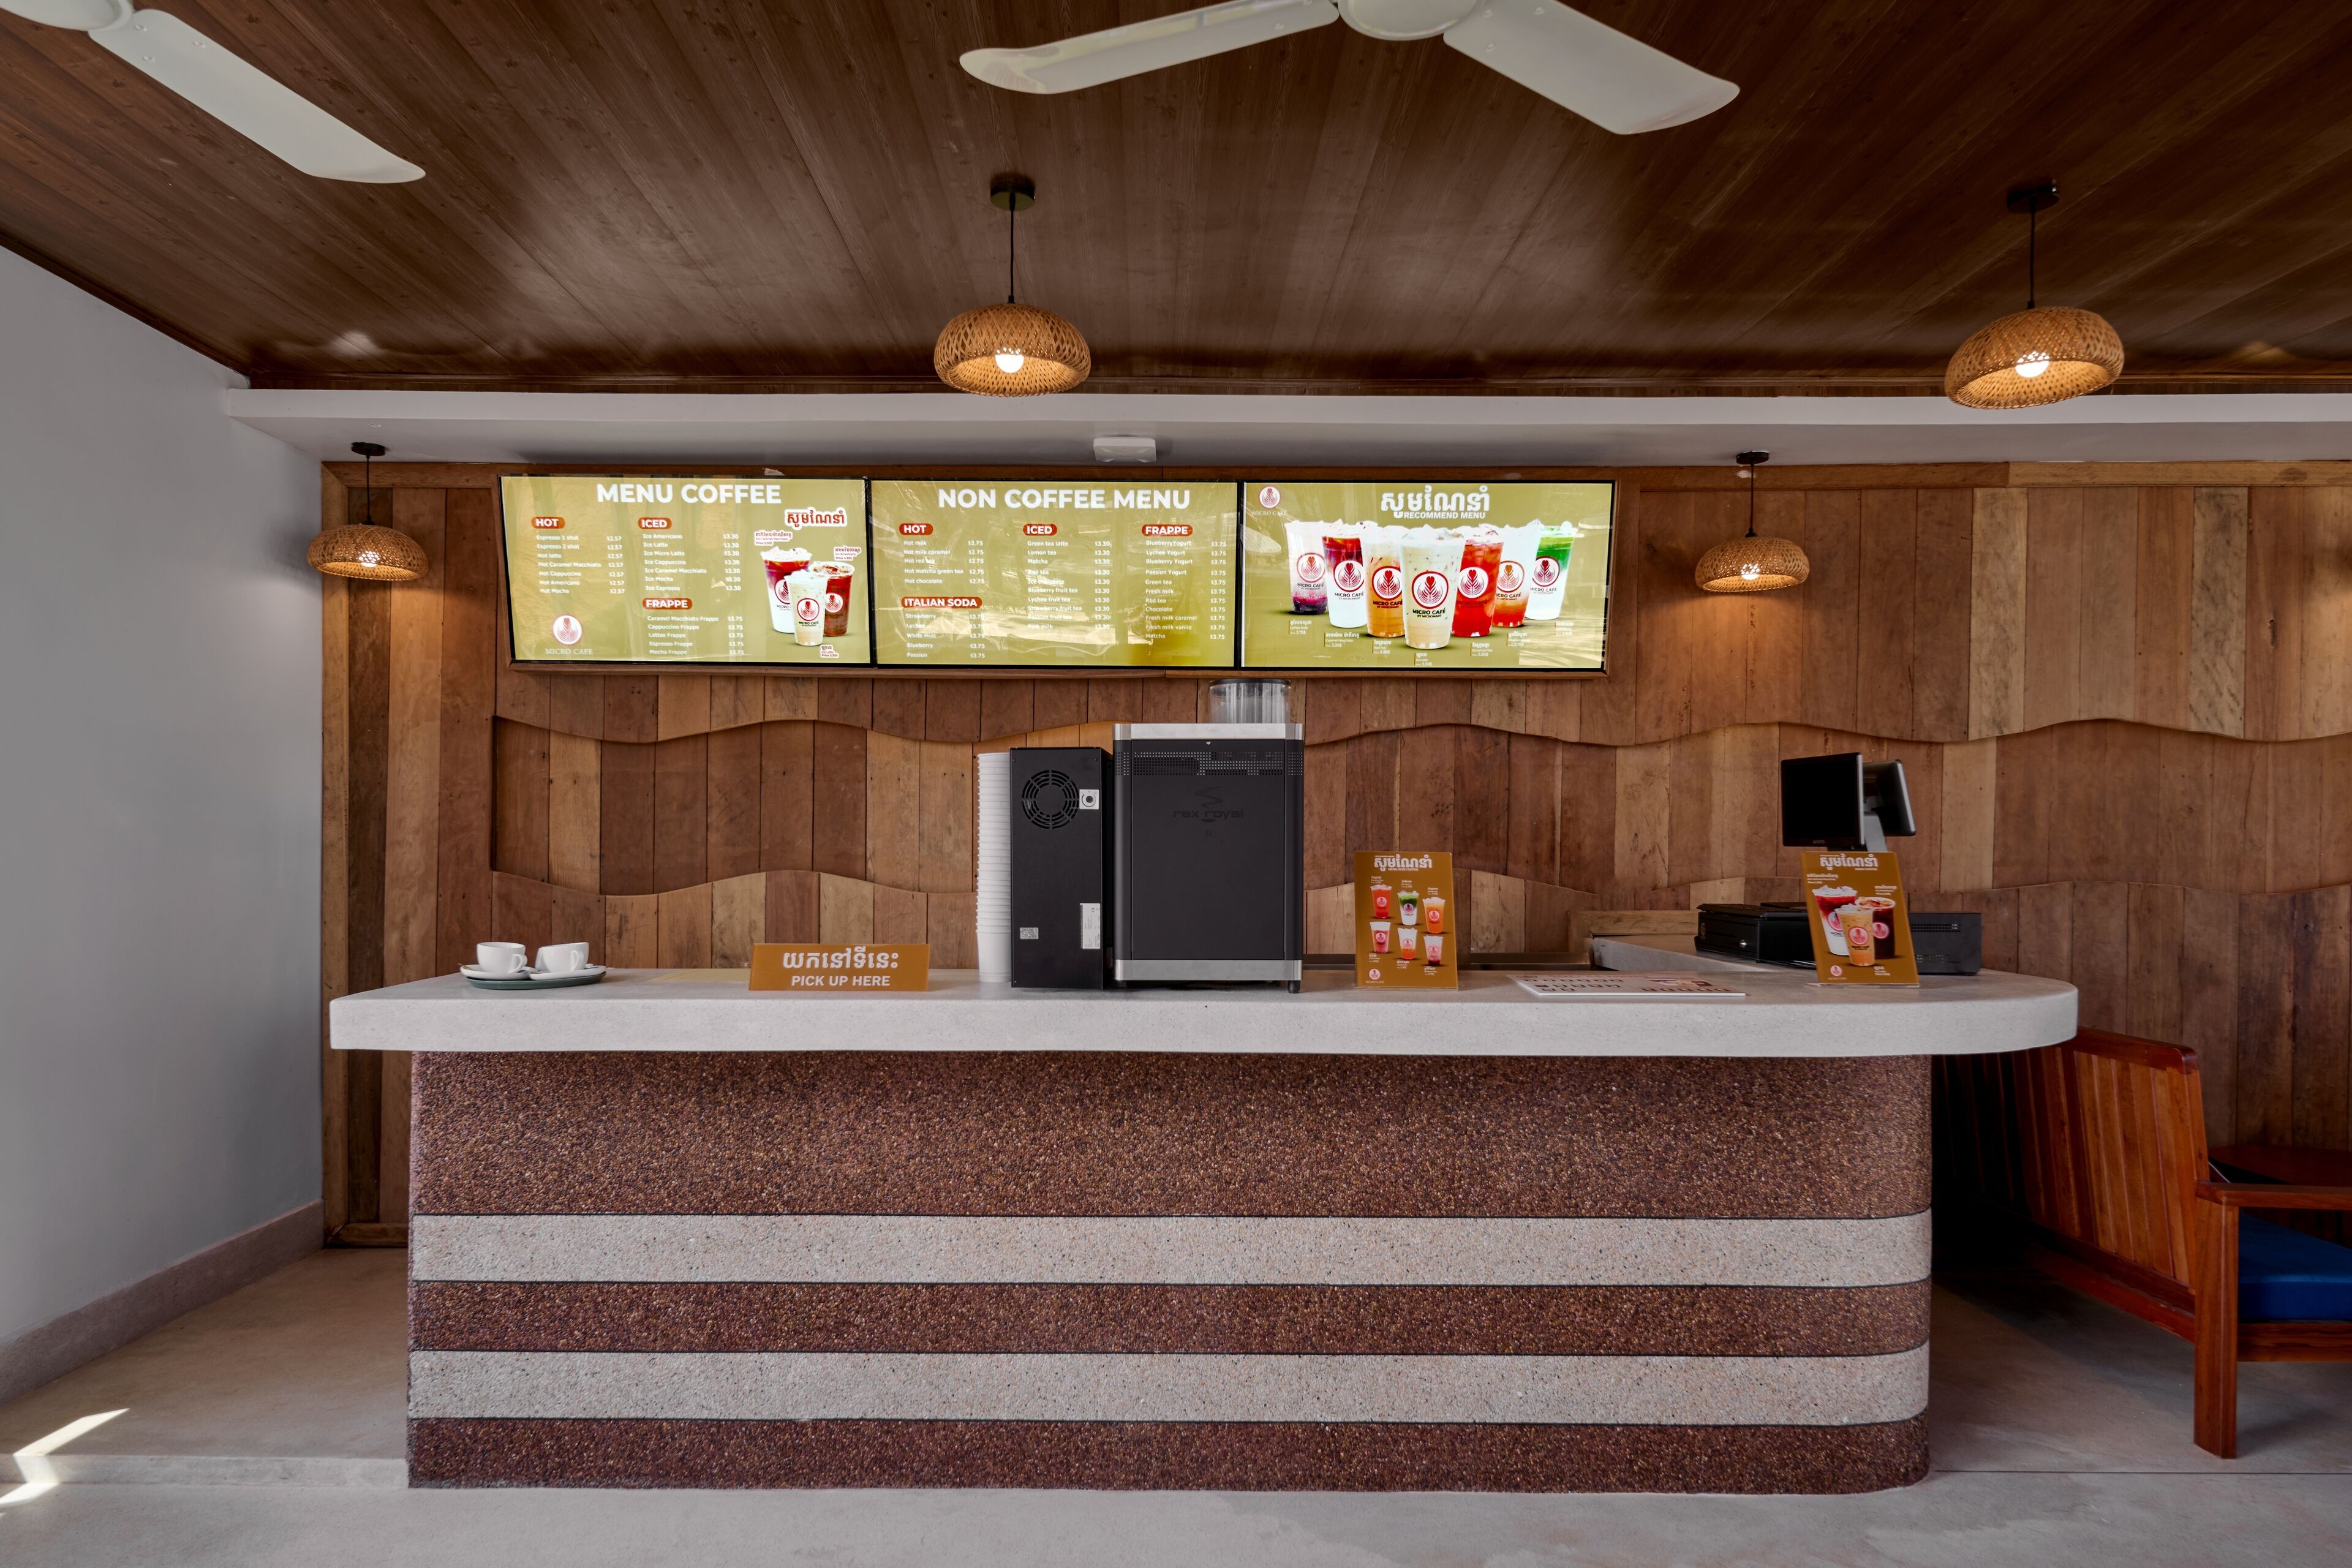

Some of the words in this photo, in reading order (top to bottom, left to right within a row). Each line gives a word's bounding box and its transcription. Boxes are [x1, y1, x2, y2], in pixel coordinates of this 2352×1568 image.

[597, 483, 673, 503] MENU
[681, 483, 782, 503] COFFEE
[938, 489, 997, 508] NON
[1005, 489, 1105, 509] COFFEE
[1114, 489, 1191, 509] MENU
[1381, 485, 1490, 518] សូមណែនាំ
[787, 510, 845, 527] សូមណែនាំ
[1027, 526, 1052, 534] ICED
[1145, 526, 1188, 535] FRAPPE
[1205, 809, 1243, 820] royal
[1374, 854, 1432, 872] សូមណែនាំ
[1820, 853, 1878, 870] សូមណែនាំ
[783, 946, 899, 969] យកនៅទីនេះ
[791, 976, 824, 986] PICK
[829, 976, 848, 986] UP
[853, 976, 890, 986] HERE
